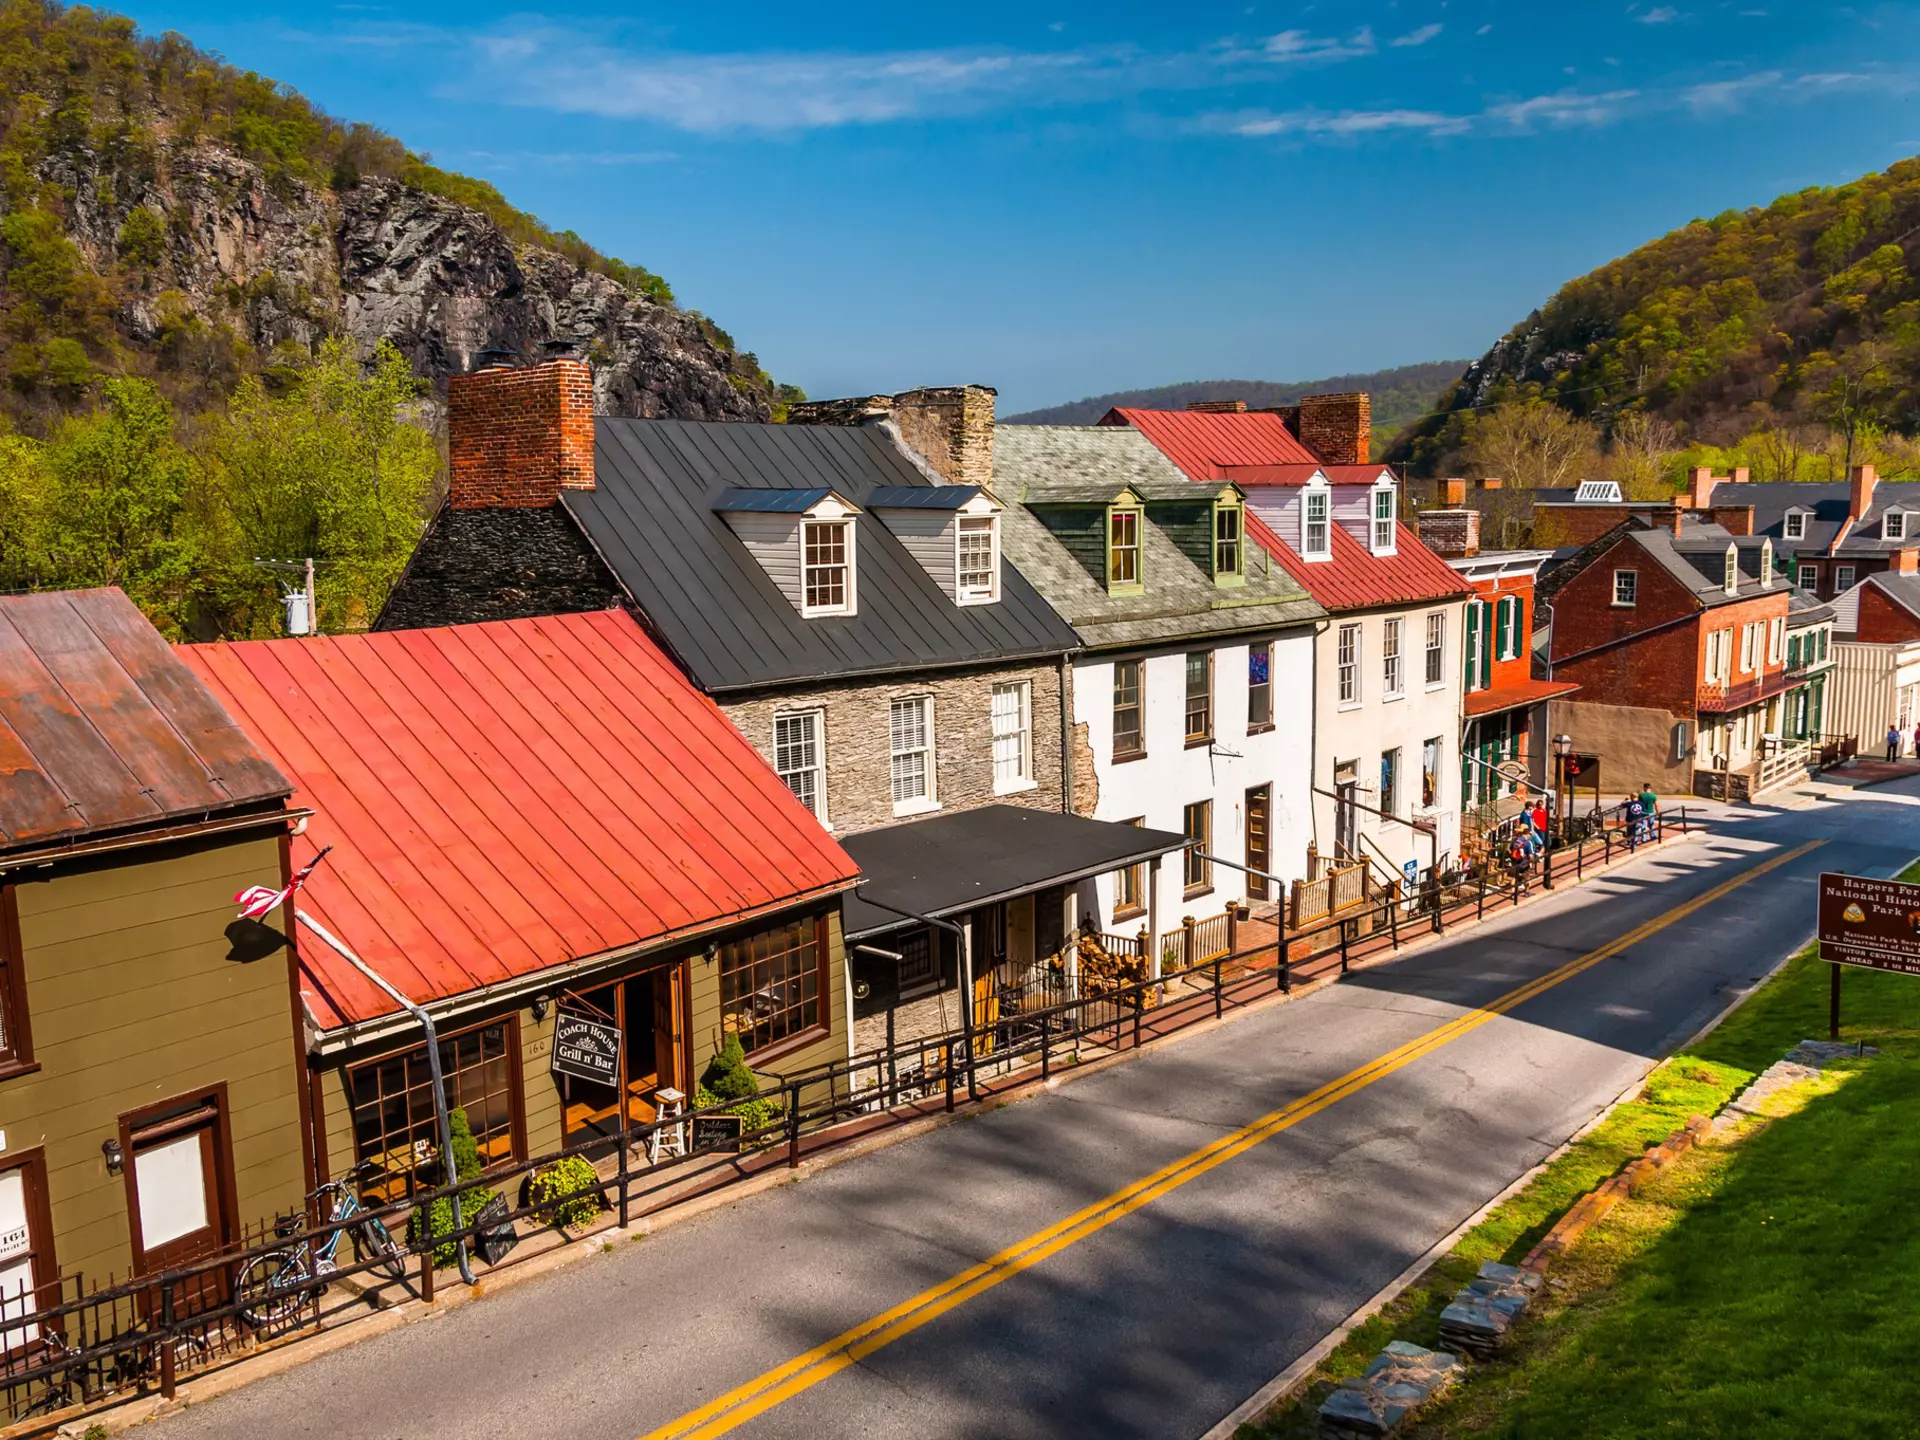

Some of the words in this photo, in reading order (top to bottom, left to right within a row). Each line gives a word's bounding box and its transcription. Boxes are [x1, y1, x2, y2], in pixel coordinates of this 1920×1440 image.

[1843, 879, 1894, 892] Harpers
[1826, 887, 1880, 901] National
[1885, 895, 1920, 907] Histo
[1872, 904, 1902, 916] Park
[1843, 937, 1888, 948] Department
[1844, 931, 1877, 941] National
[1880, 935, 1898, 944] Park
[1834, 946, 1867, 956] VISITOR
[1869, 951, 1903, 962] CENTER
[1845, 956, 1873, 965] AHEAD
[558, 1023, 588, 1040] COACH
[590, 1025, 618, 1055] HOUSE
[529, 1041, 545, 1055] 160
[559, 1045, 582, 1061] Grill
[595, 1056, 613, 1070] Bar
[3, 1230, 25, 1244] 164
